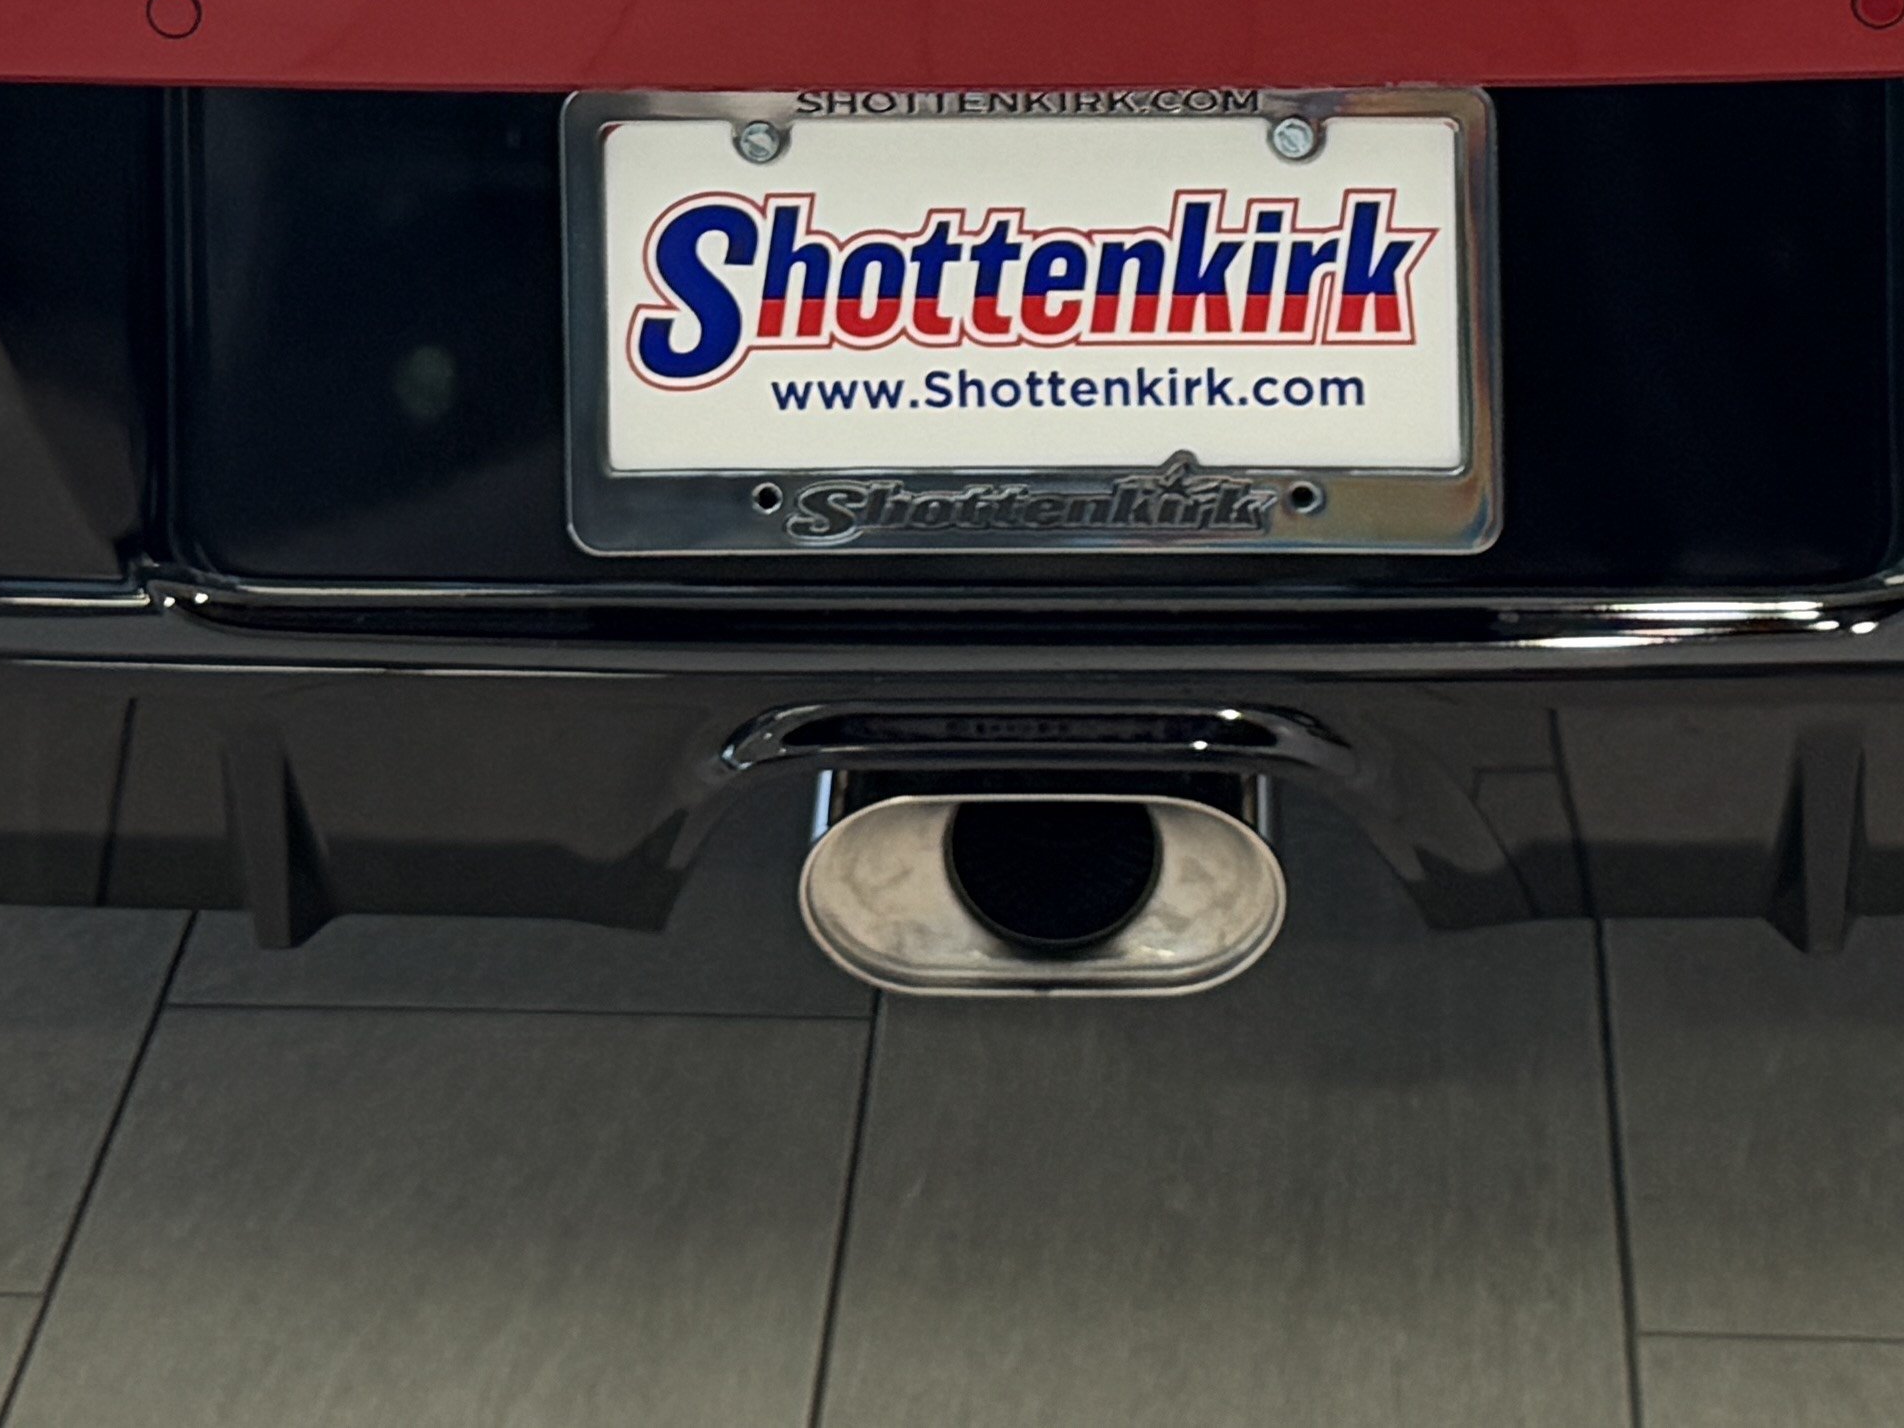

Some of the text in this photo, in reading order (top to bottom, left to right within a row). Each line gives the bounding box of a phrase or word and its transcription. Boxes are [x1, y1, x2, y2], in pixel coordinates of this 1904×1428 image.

[794, 89, 1260, 114] SHOTTENKIRK.COM
[630, 192, 1434, 389] Shottenkirk
[771, 367, 1365, 410] www.Shottenkirk.com
[784, 472, 1276, 536] Shottenkirk
